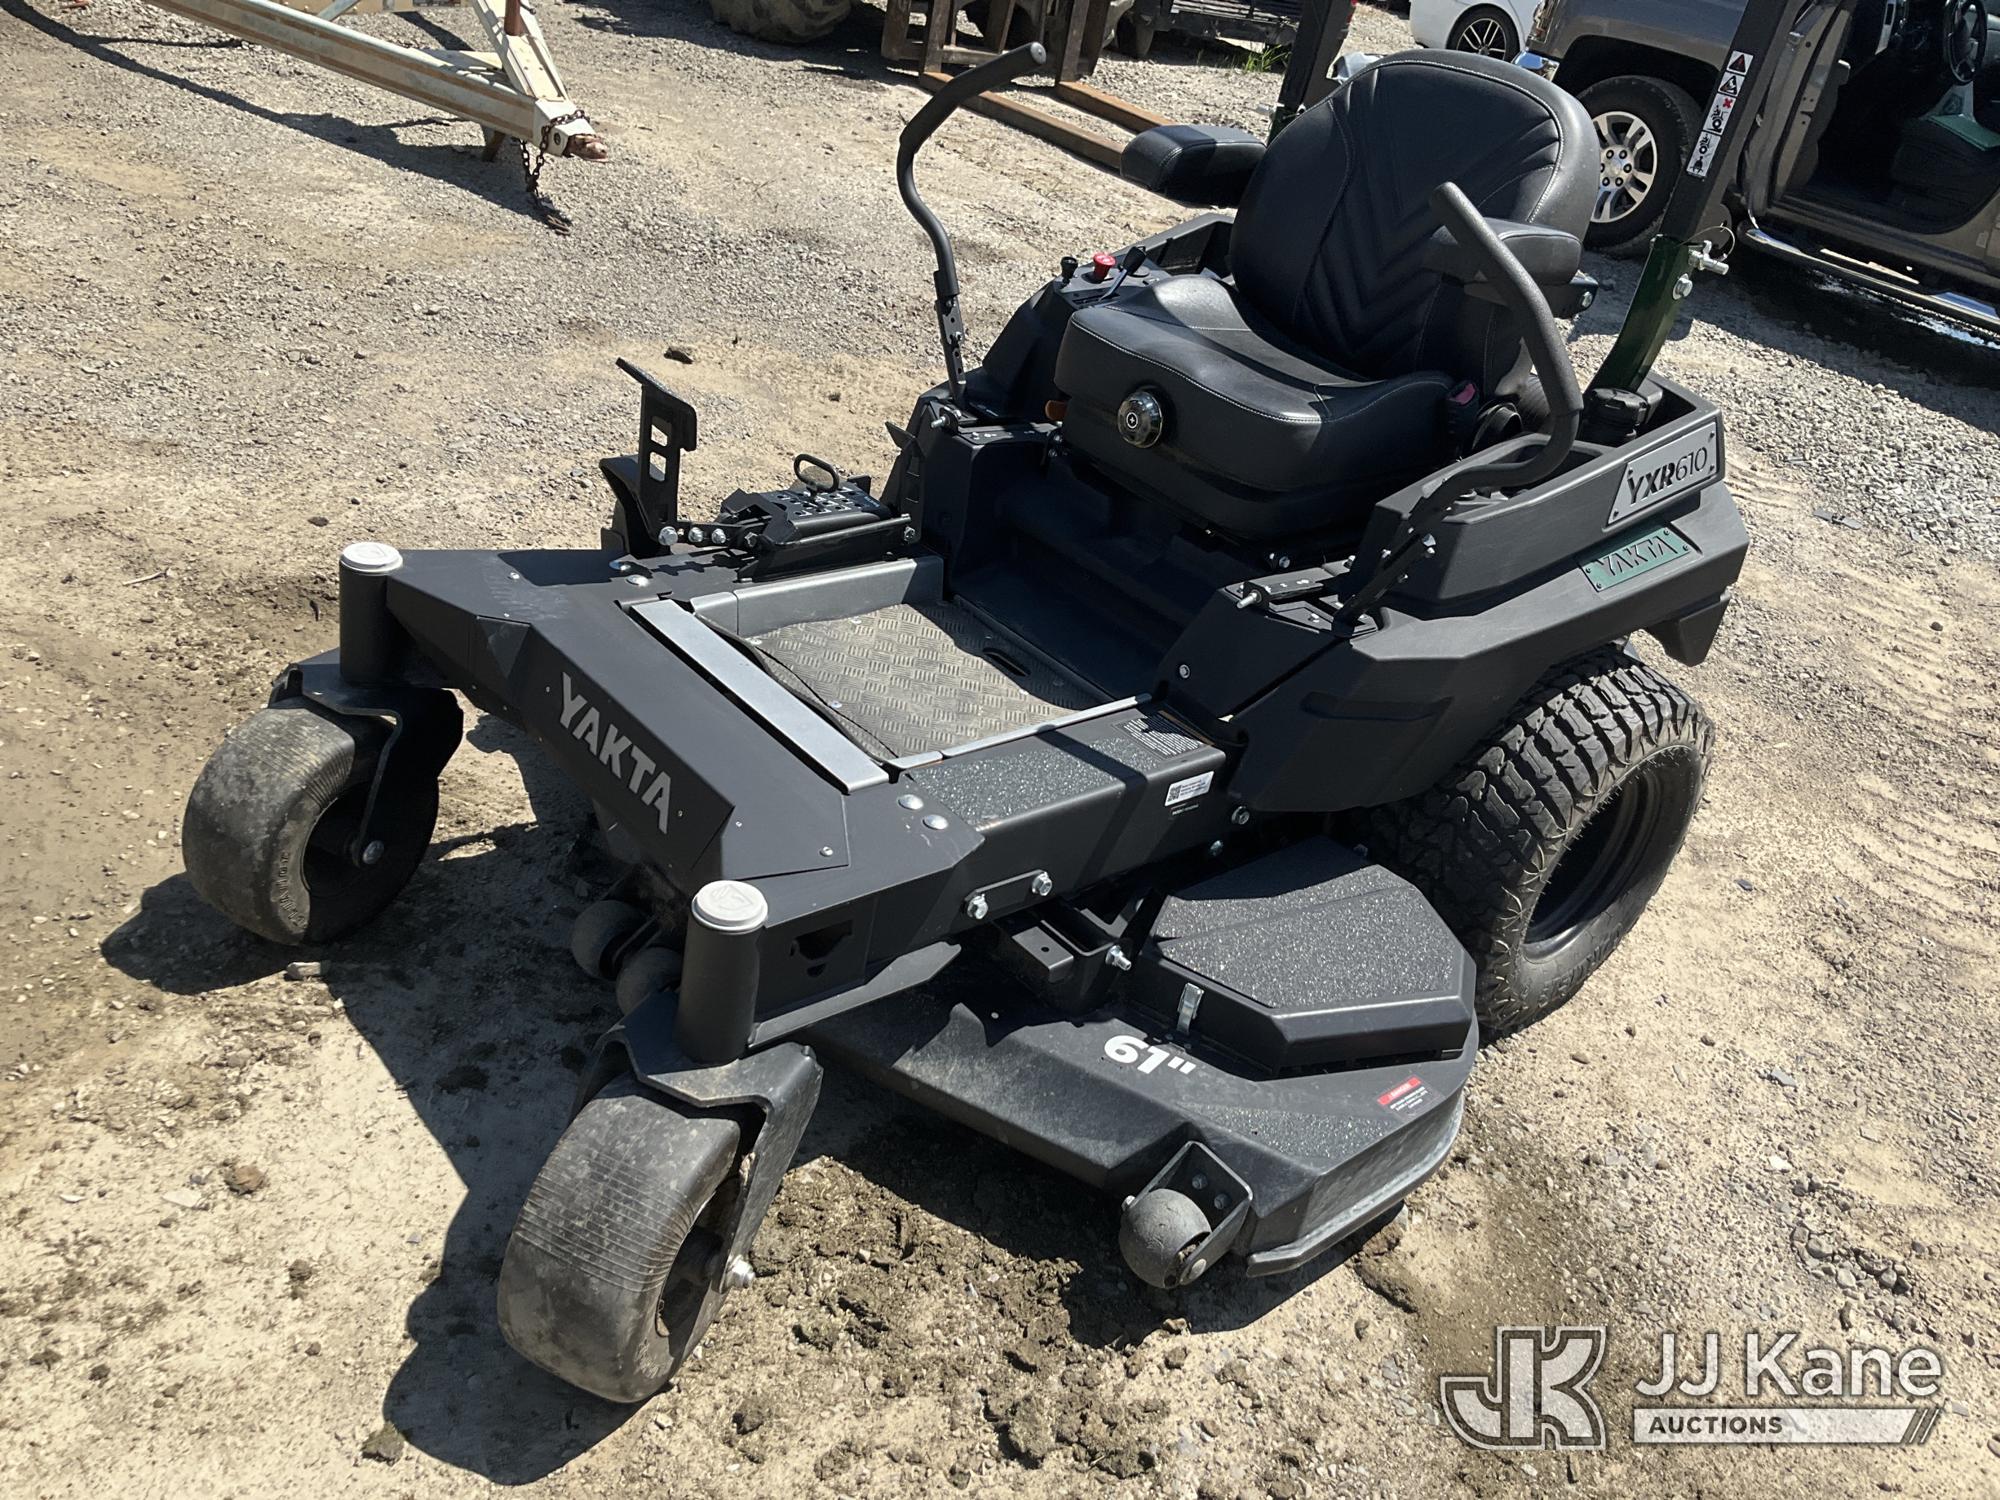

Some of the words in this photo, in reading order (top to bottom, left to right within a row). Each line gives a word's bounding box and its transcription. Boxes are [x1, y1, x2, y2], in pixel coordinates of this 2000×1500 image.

[1627, 446, 1708, 505] YXR610
[1592, 535, 1679, 577] YAKTA
[559, 671, 672, 835] YAKTA
[1104, 1034, 1197, 1075] 61"
